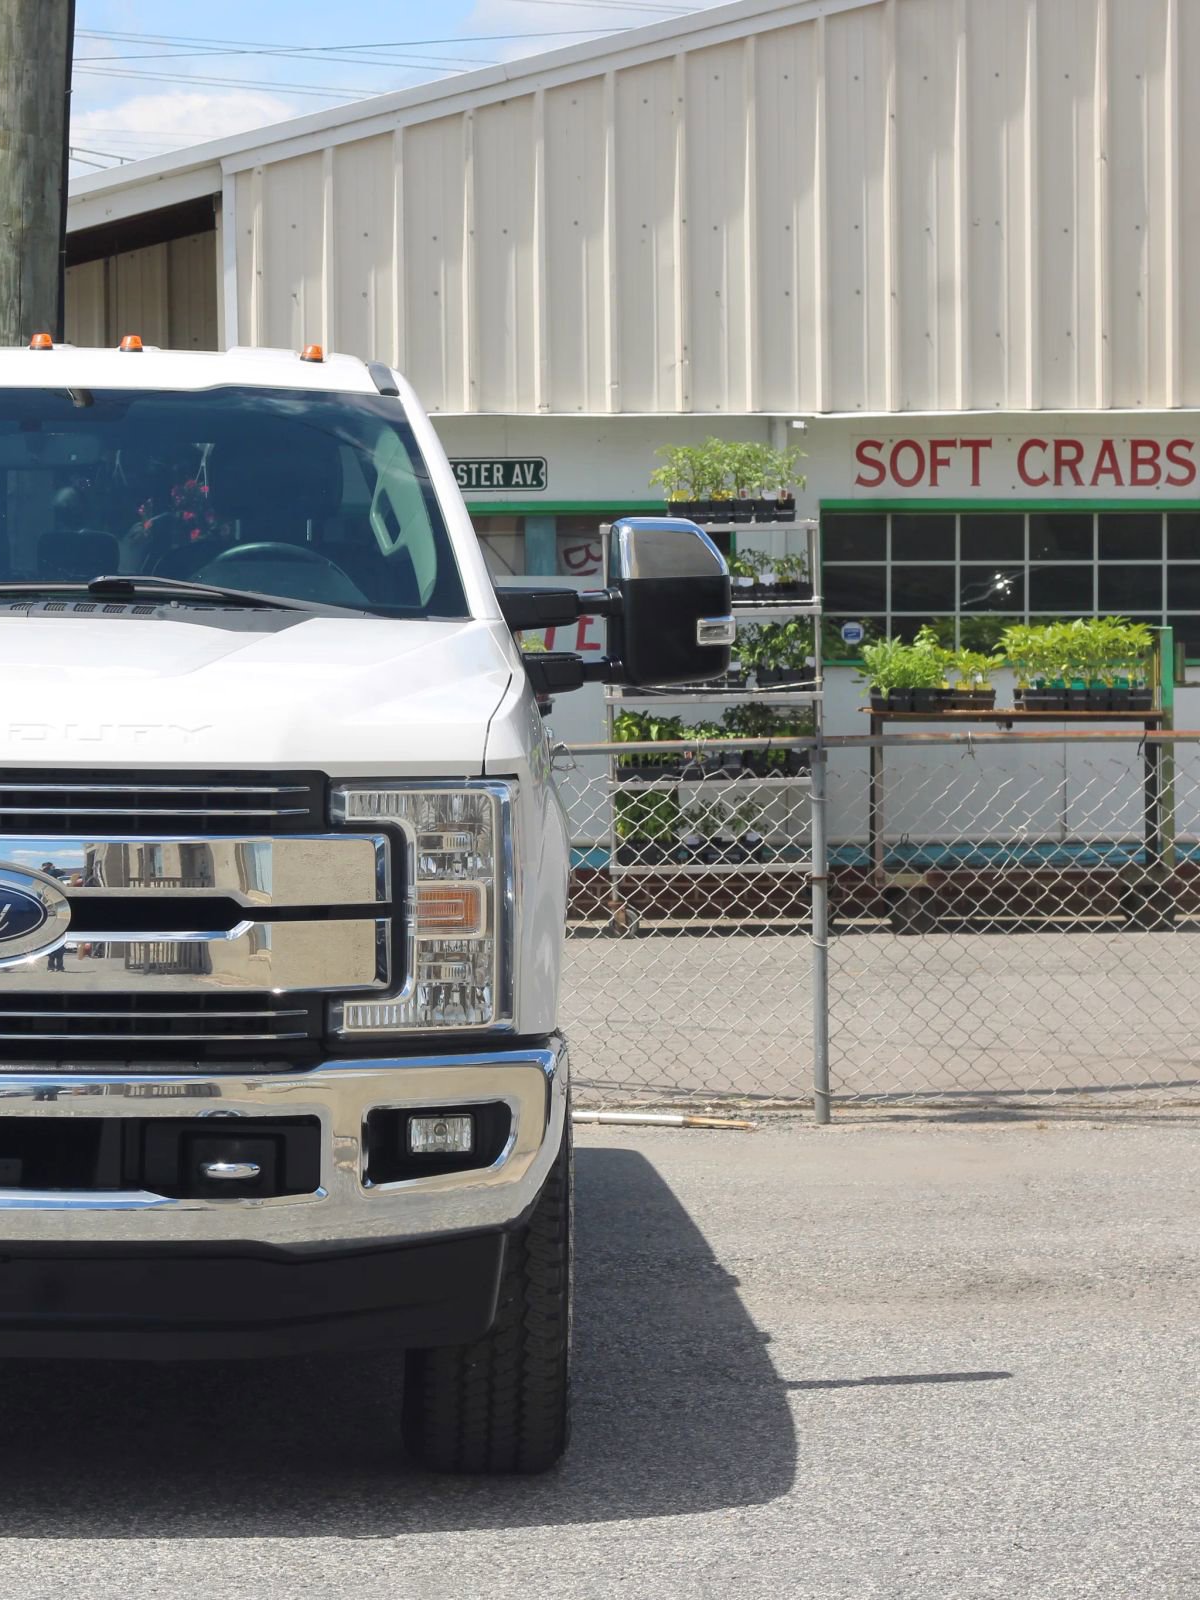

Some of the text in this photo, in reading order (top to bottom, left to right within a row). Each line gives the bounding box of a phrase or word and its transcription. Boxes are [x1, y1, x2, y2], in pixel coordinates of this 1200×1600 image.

[855, 438, 1197, 487] SOFT CRABS
[450, 463, 537, 486] STER AV.
[7, 723, 212, 742] DUTY
